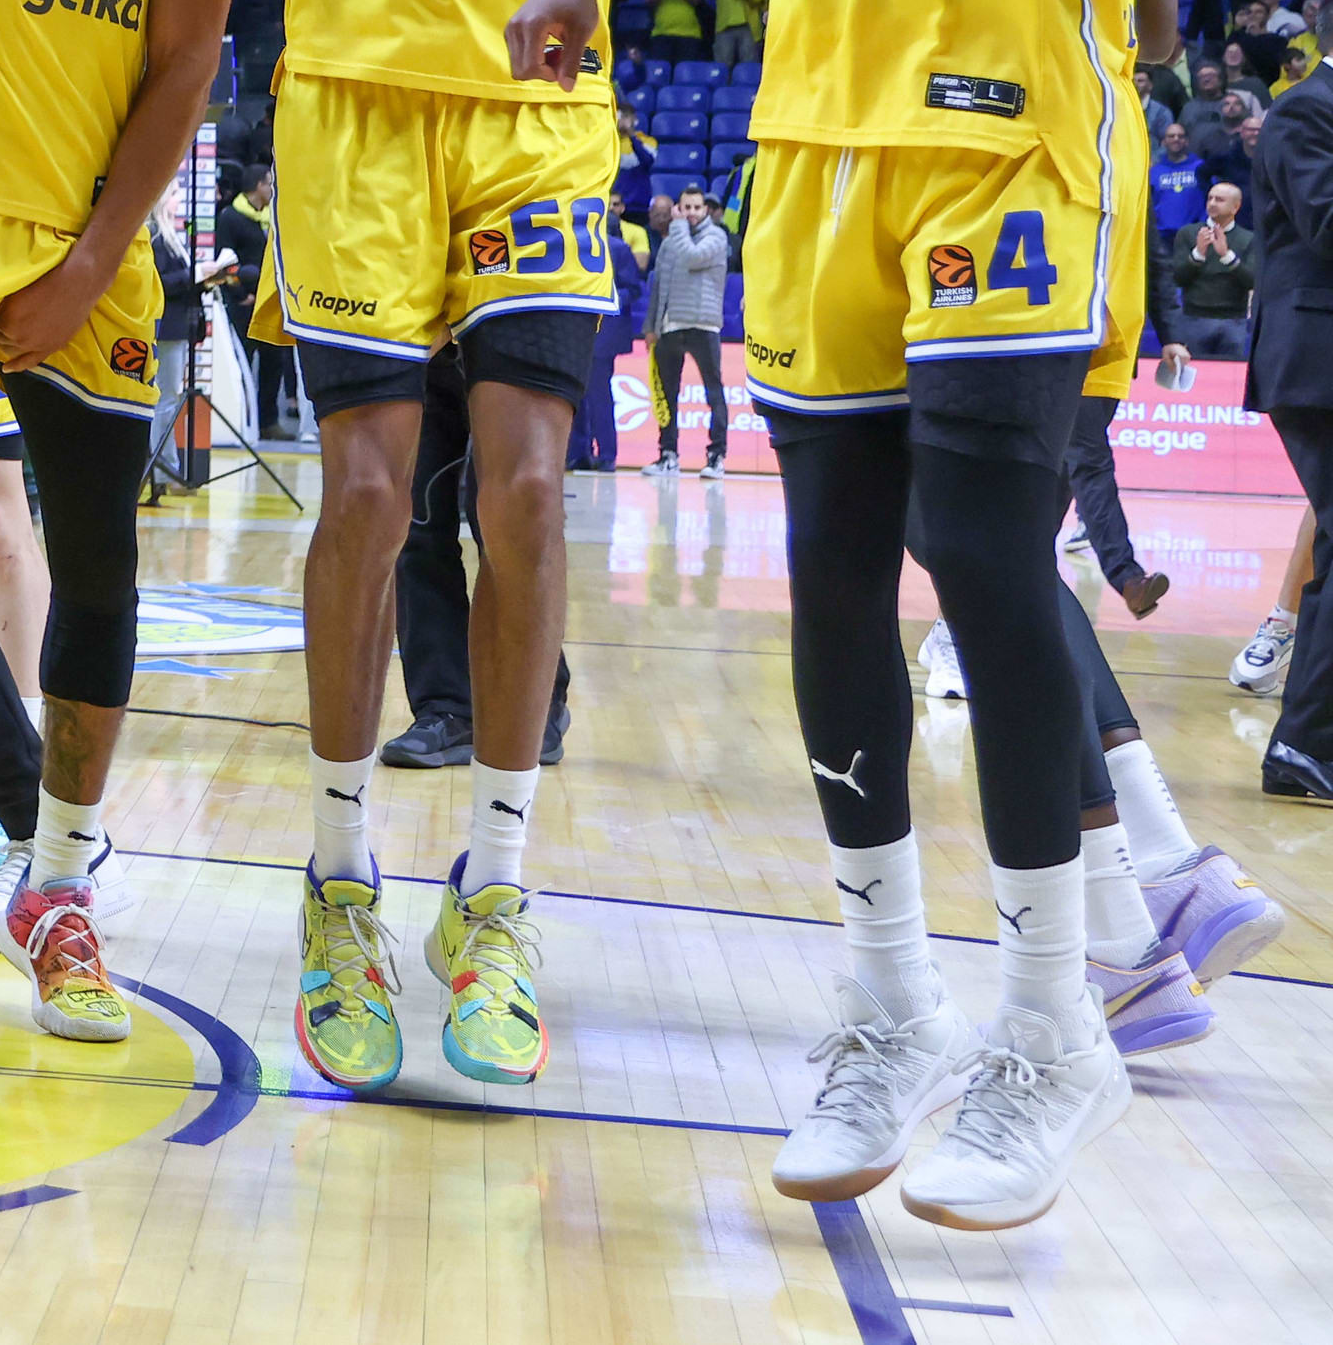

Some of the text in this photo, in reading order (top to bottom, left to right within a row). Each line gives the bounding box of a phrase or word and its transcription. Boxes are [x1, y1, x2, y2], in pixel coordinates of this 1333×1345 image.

[988, 84, 999, 99] L
[509, 197, 605, 274] 50
[477, 261, 507, 274] TURKISH
[987, 210, 1057, 306] 4
[933, 294, 973, 303] AIRLINES
[934, 286, 973, 297] TURKISH
[310, 289, 377, 319] Rapyd
[745, 333, 797, 369] Rapyd
[1151, 402, 1262, 426] AIRLINES
